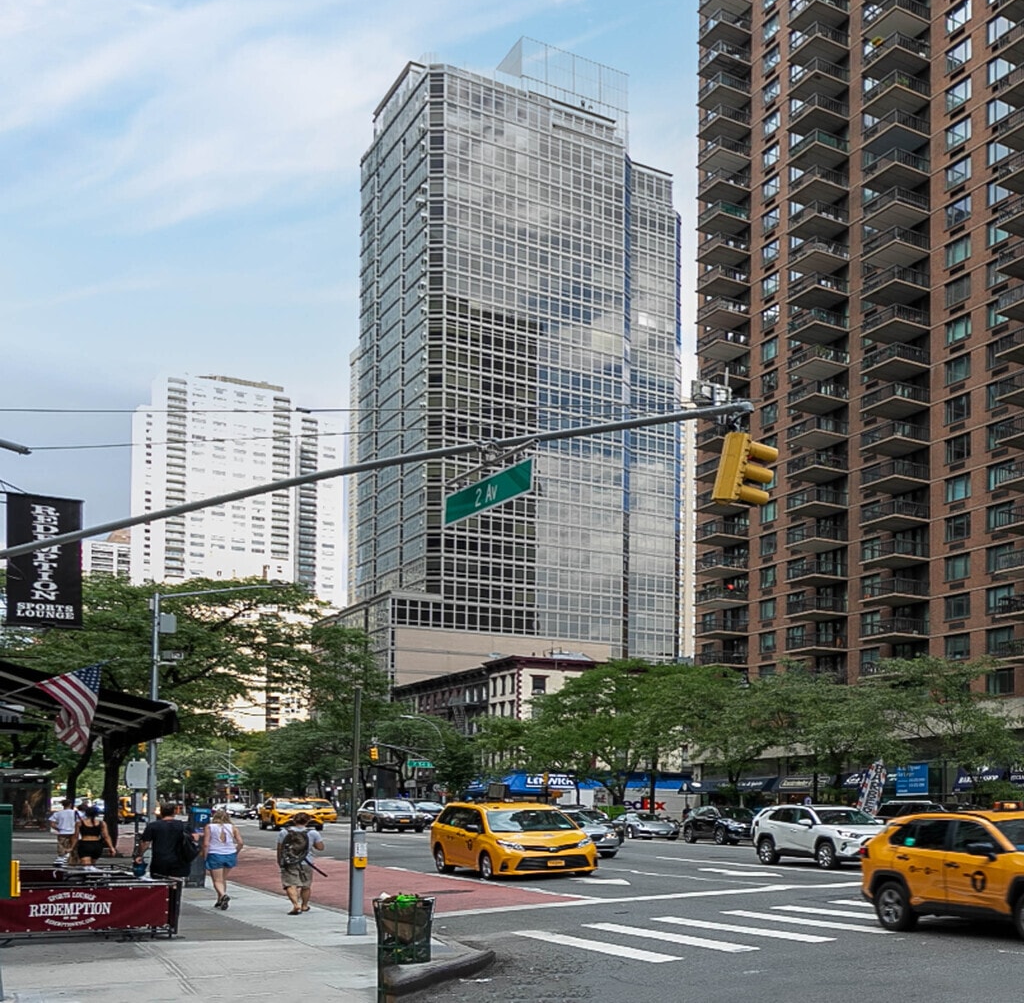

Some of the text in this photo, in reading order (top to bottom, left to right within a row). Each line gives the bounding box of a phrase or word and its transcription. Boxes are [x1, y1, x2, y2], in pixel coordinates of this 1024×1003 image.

[475, 484, 498, 507] 2 Av
[16, 602, 74, 612] SPORTS
[16, 610, 75, 620] LOUNGE
[622, 797, 667, 811] edEx
[29, 902, 112, 917] REDEMPTION
